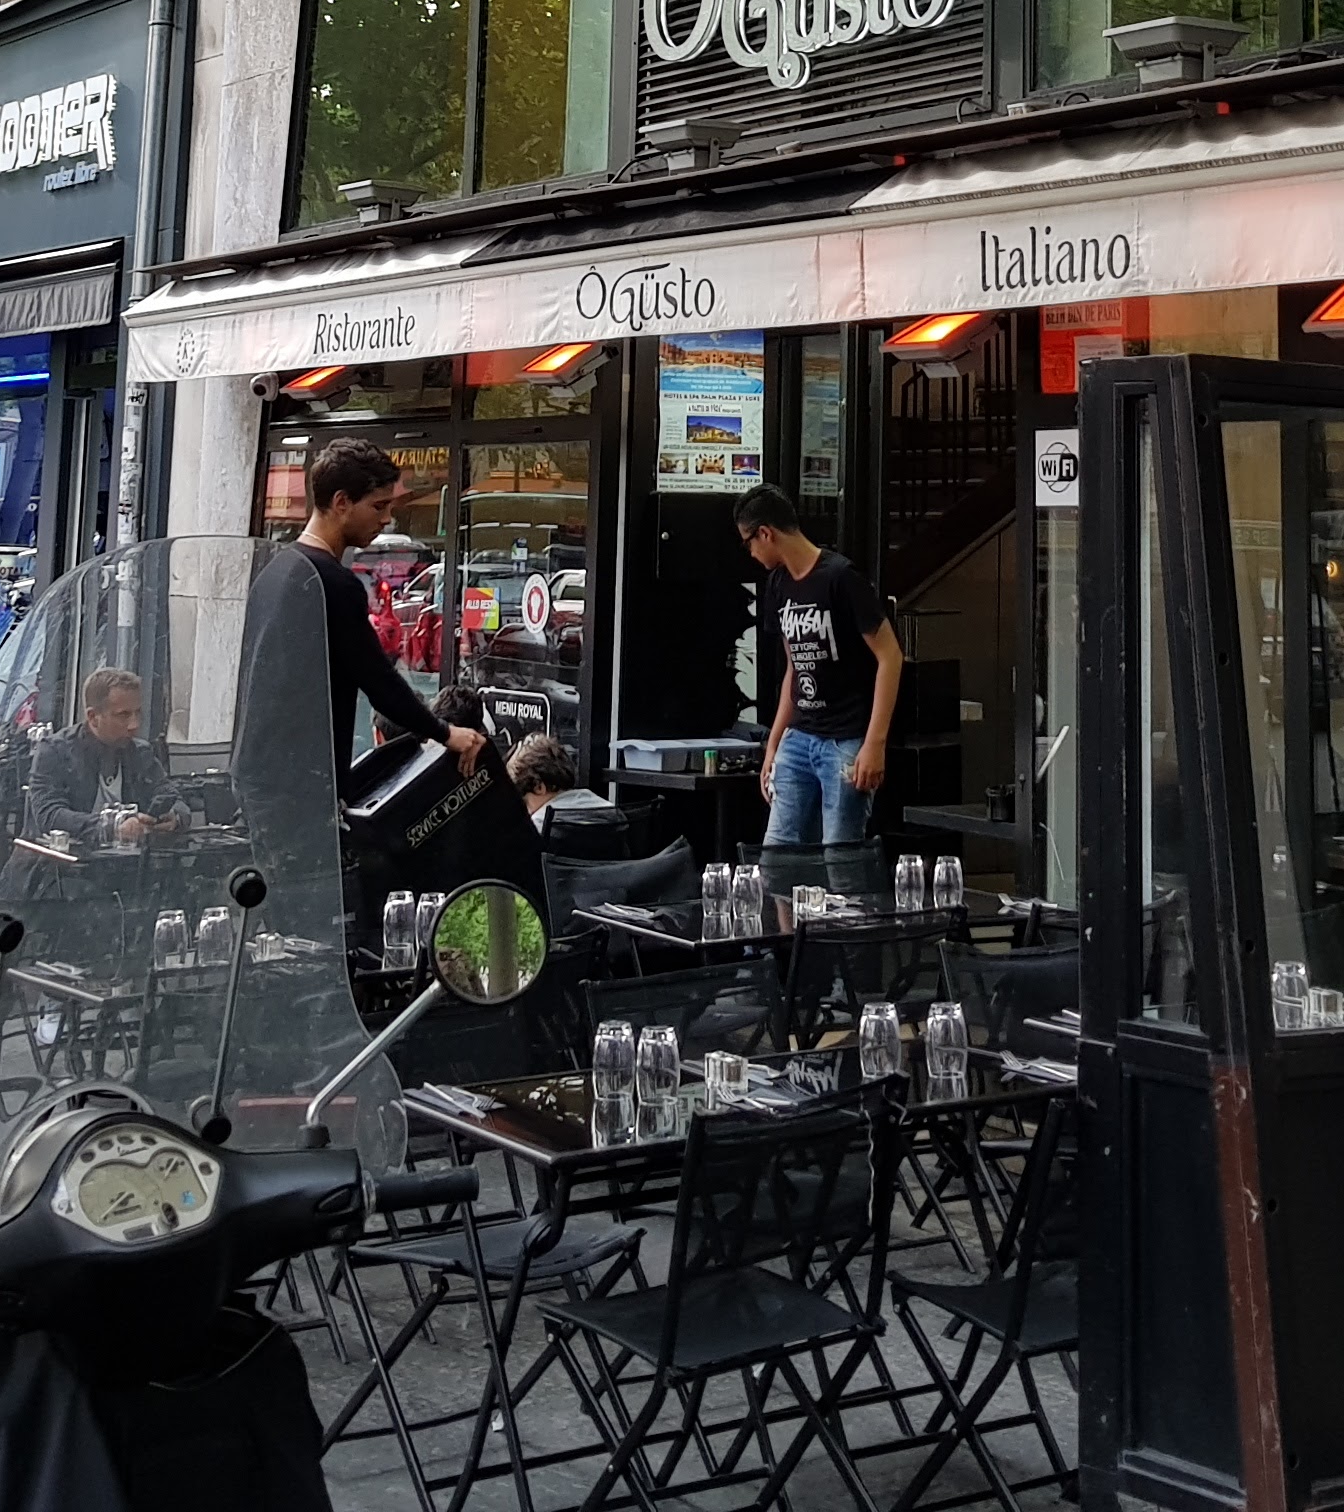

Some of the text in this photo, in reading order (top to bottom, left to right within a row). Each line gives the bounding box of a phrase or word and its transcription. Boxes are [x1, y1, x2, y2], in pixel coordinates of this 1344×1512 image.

[980, 226, 1131, 292] Italiano
[313, 305, 416, 354] Ristorante
[1085, 305, 1095, 322] DE
[1097, 304, 1121, 322] PARIS
[494, 700, 544, 720] MENU ROYAL
[406, 768, 491, 847] SERVICE VOITURIER
